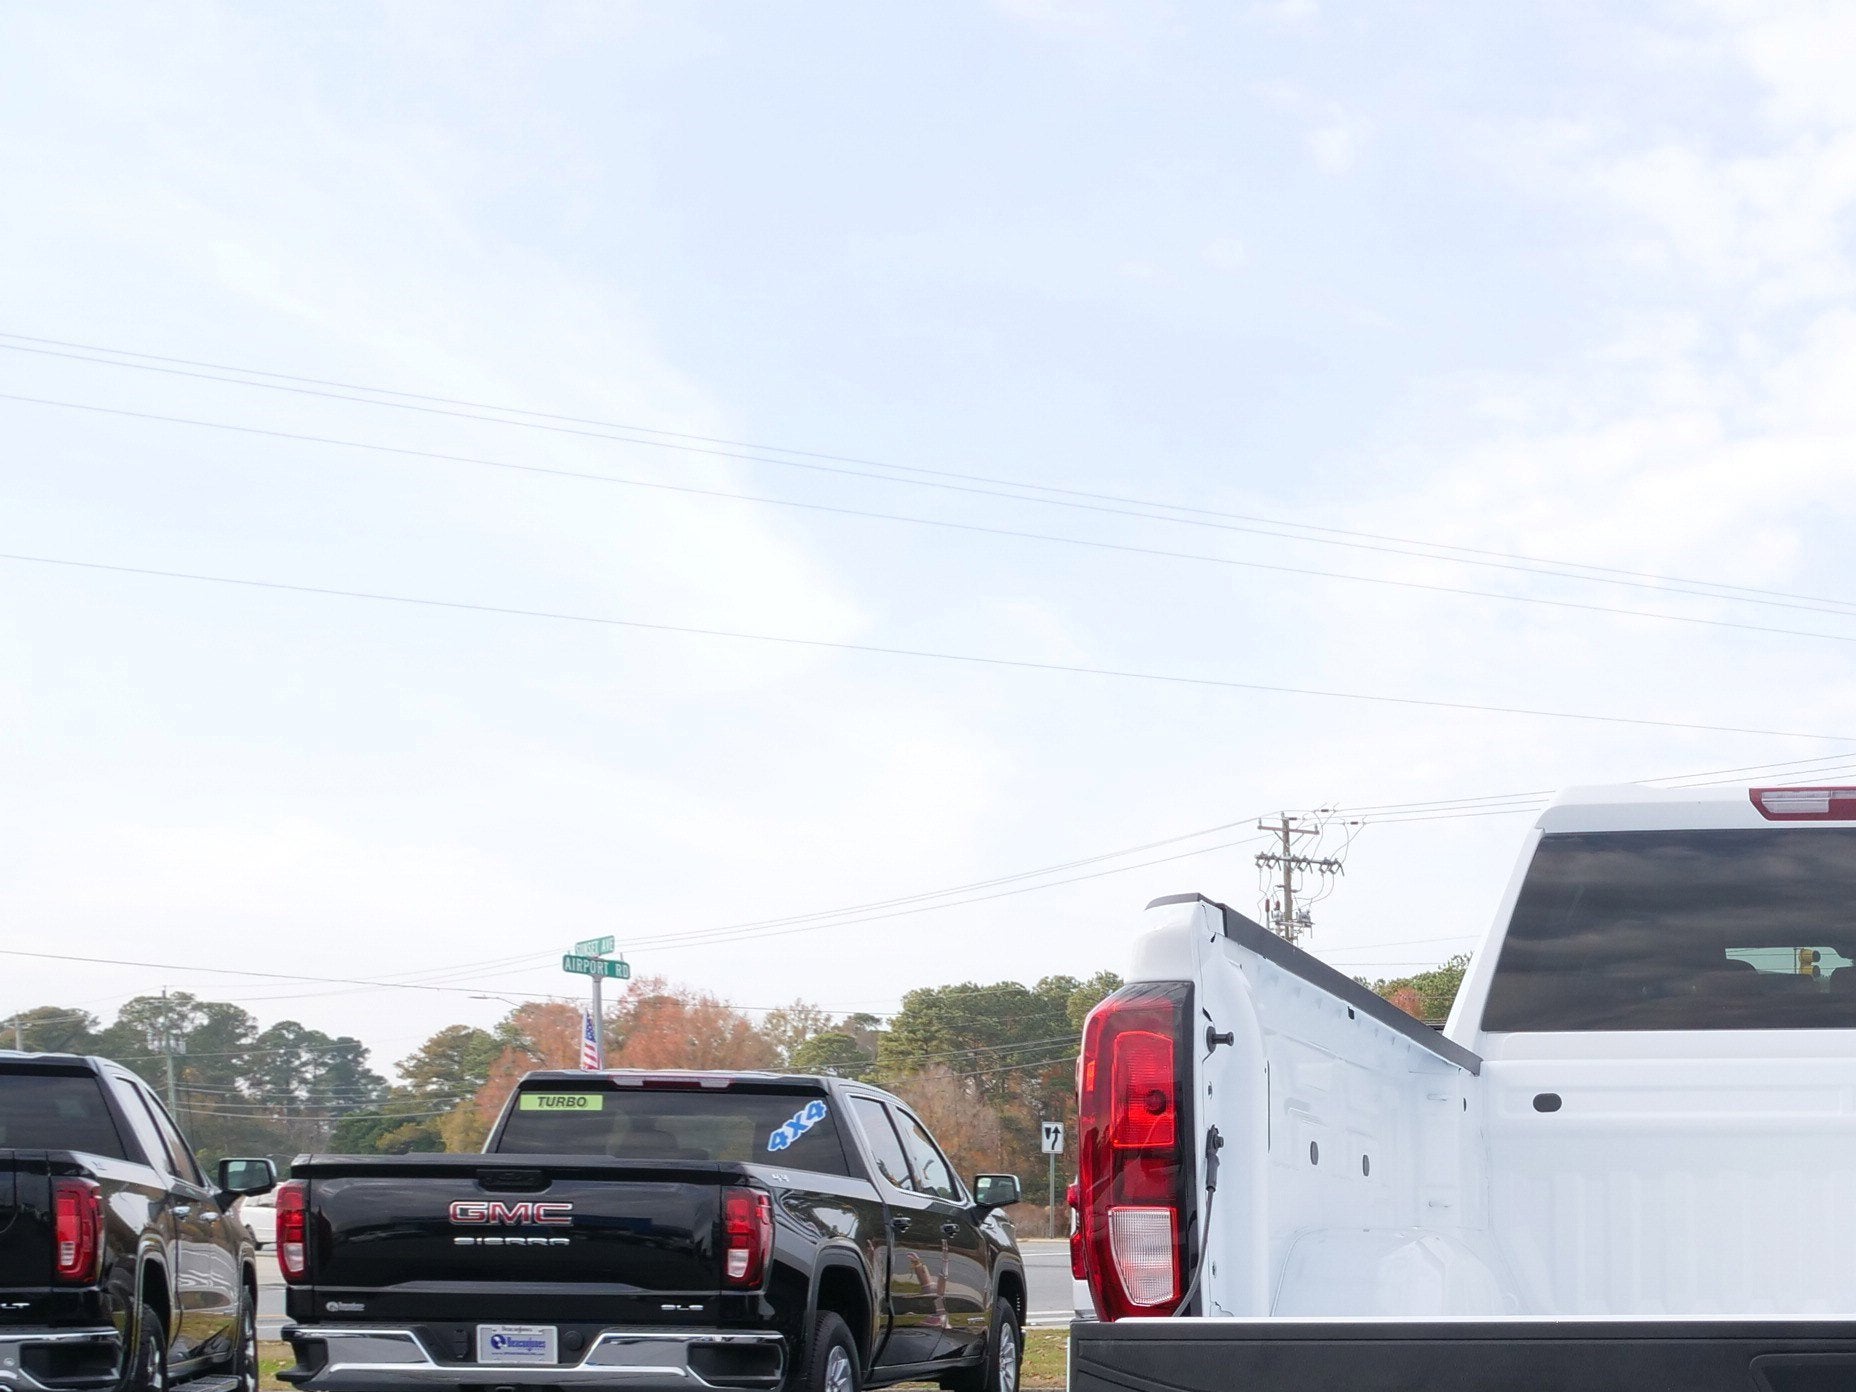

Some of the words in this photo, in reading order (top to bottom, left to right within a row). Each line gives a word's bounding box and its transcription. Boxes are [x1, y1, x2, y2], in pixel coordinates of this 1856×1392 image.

[601, 937, 615, 953] AVE
[564, 957, 609, 975] AIRPORT
[615, 963, 629, 978] RD
[537, 1096, 588, 1108] TURBO
[449, 1201, 573, 1226] GMC
